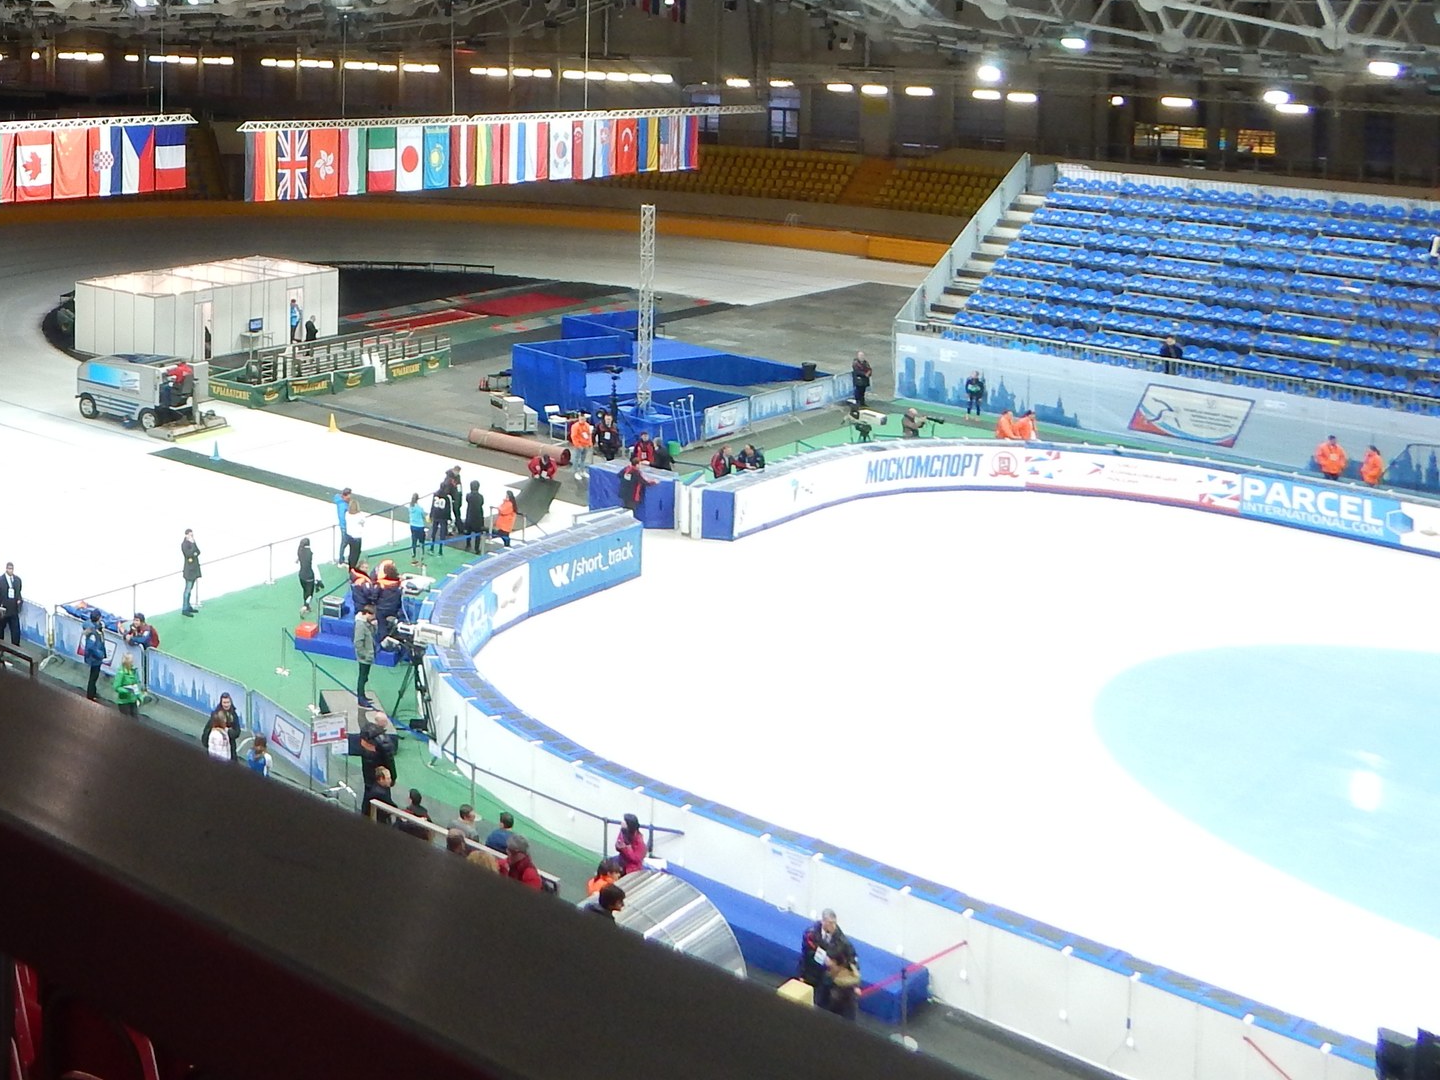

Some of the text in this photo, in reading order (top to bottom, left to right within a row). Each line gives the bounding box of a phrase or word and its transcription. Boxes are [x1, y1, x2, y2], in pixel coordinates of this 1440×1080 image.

[864, 453, 984, 484] МОСКОМСПОРТ
[1243, 477, 1384, 526] PARCEL
[1243, 501, 1384, 536] INTERNATIONAL.COM
